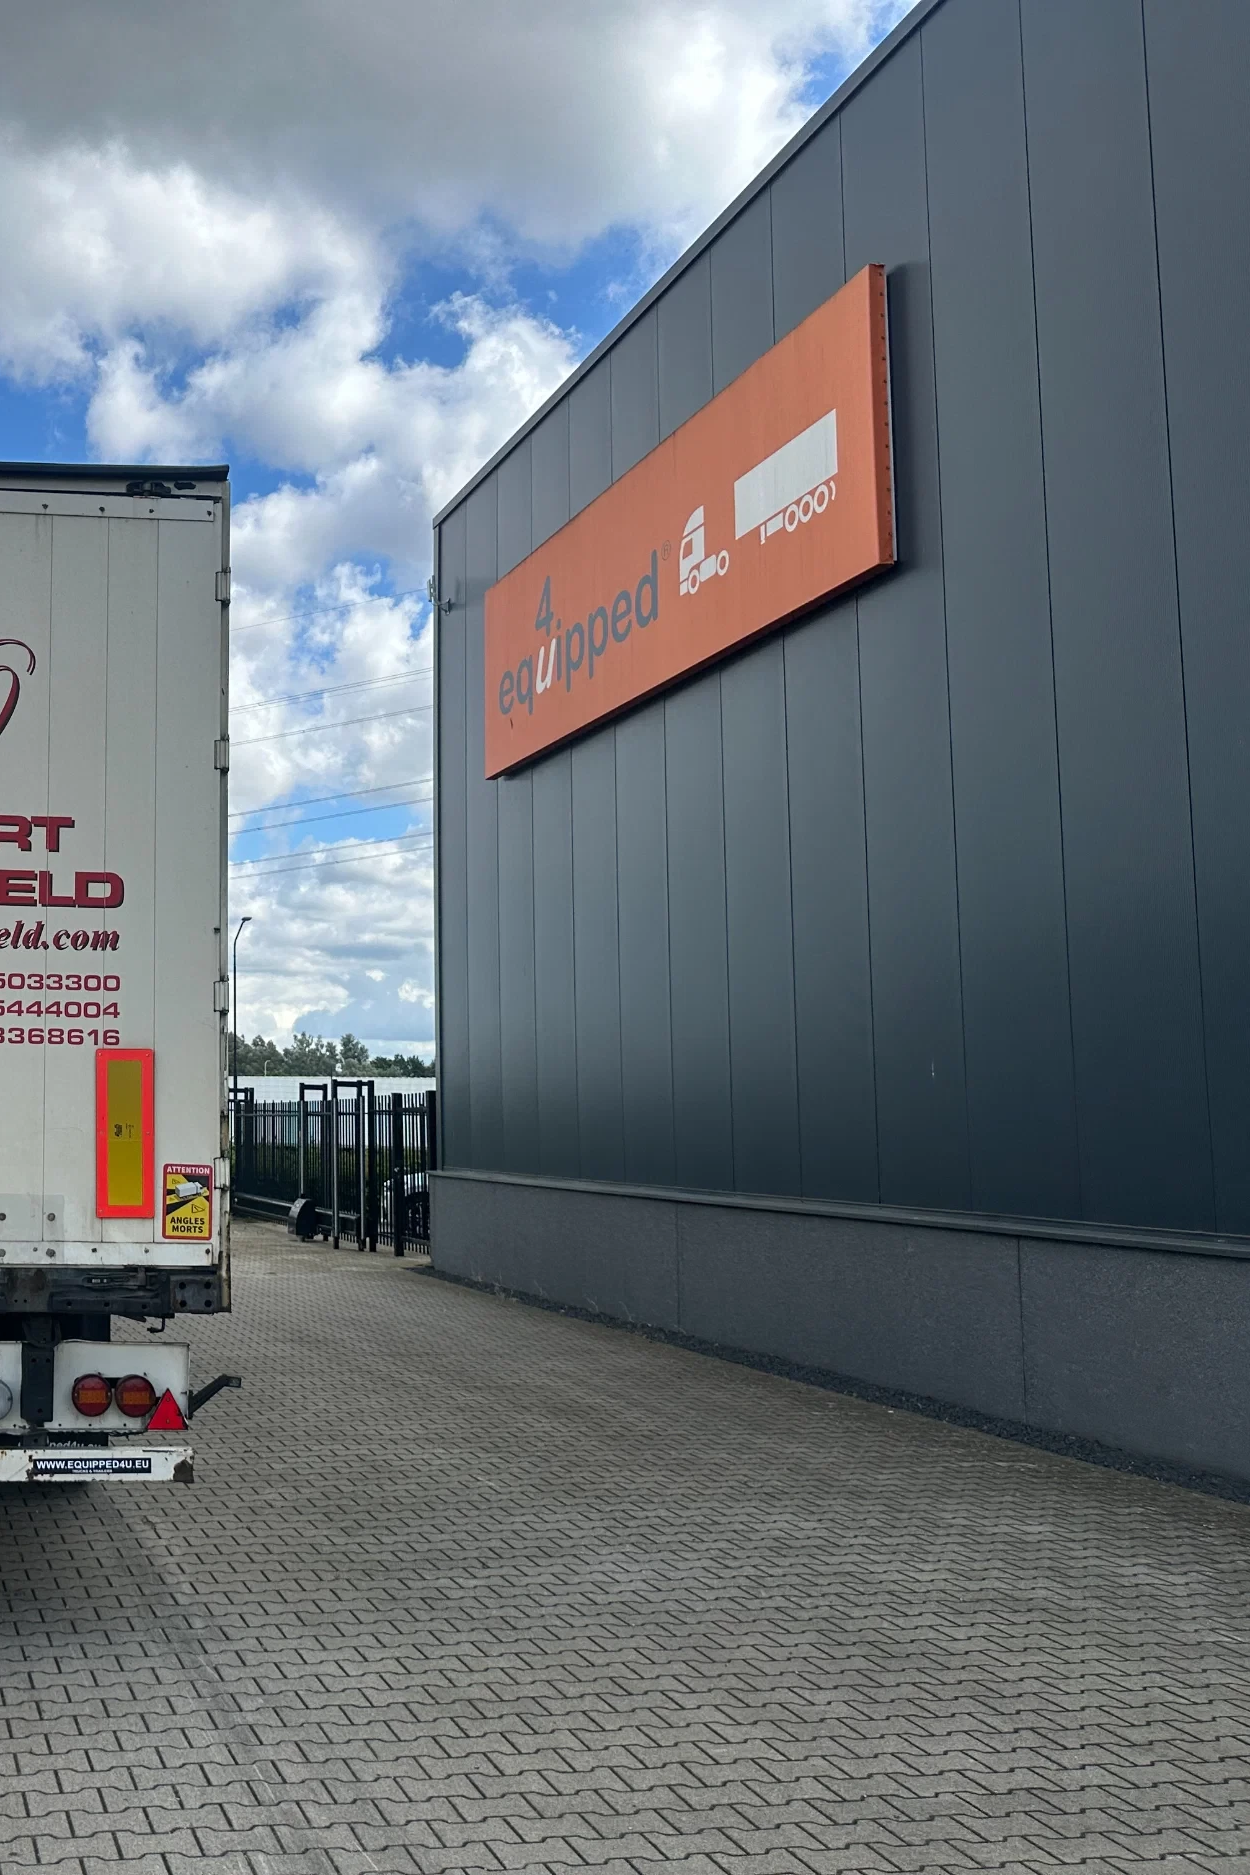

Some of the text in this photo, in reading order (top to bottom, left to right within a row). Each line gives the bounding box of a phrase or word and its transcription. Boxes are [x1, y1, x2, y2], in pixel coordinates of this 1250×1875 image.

[499, 549, 658, 715] equipped
[166, 1166, 210, 1175] ATTENTION
[170, 1216, 205, 1225] ANGLES
[171, 1225, 204, 1234] MORTS
[36, 1459, 149, 1469] WWW.EQUIPPED4U.EU
